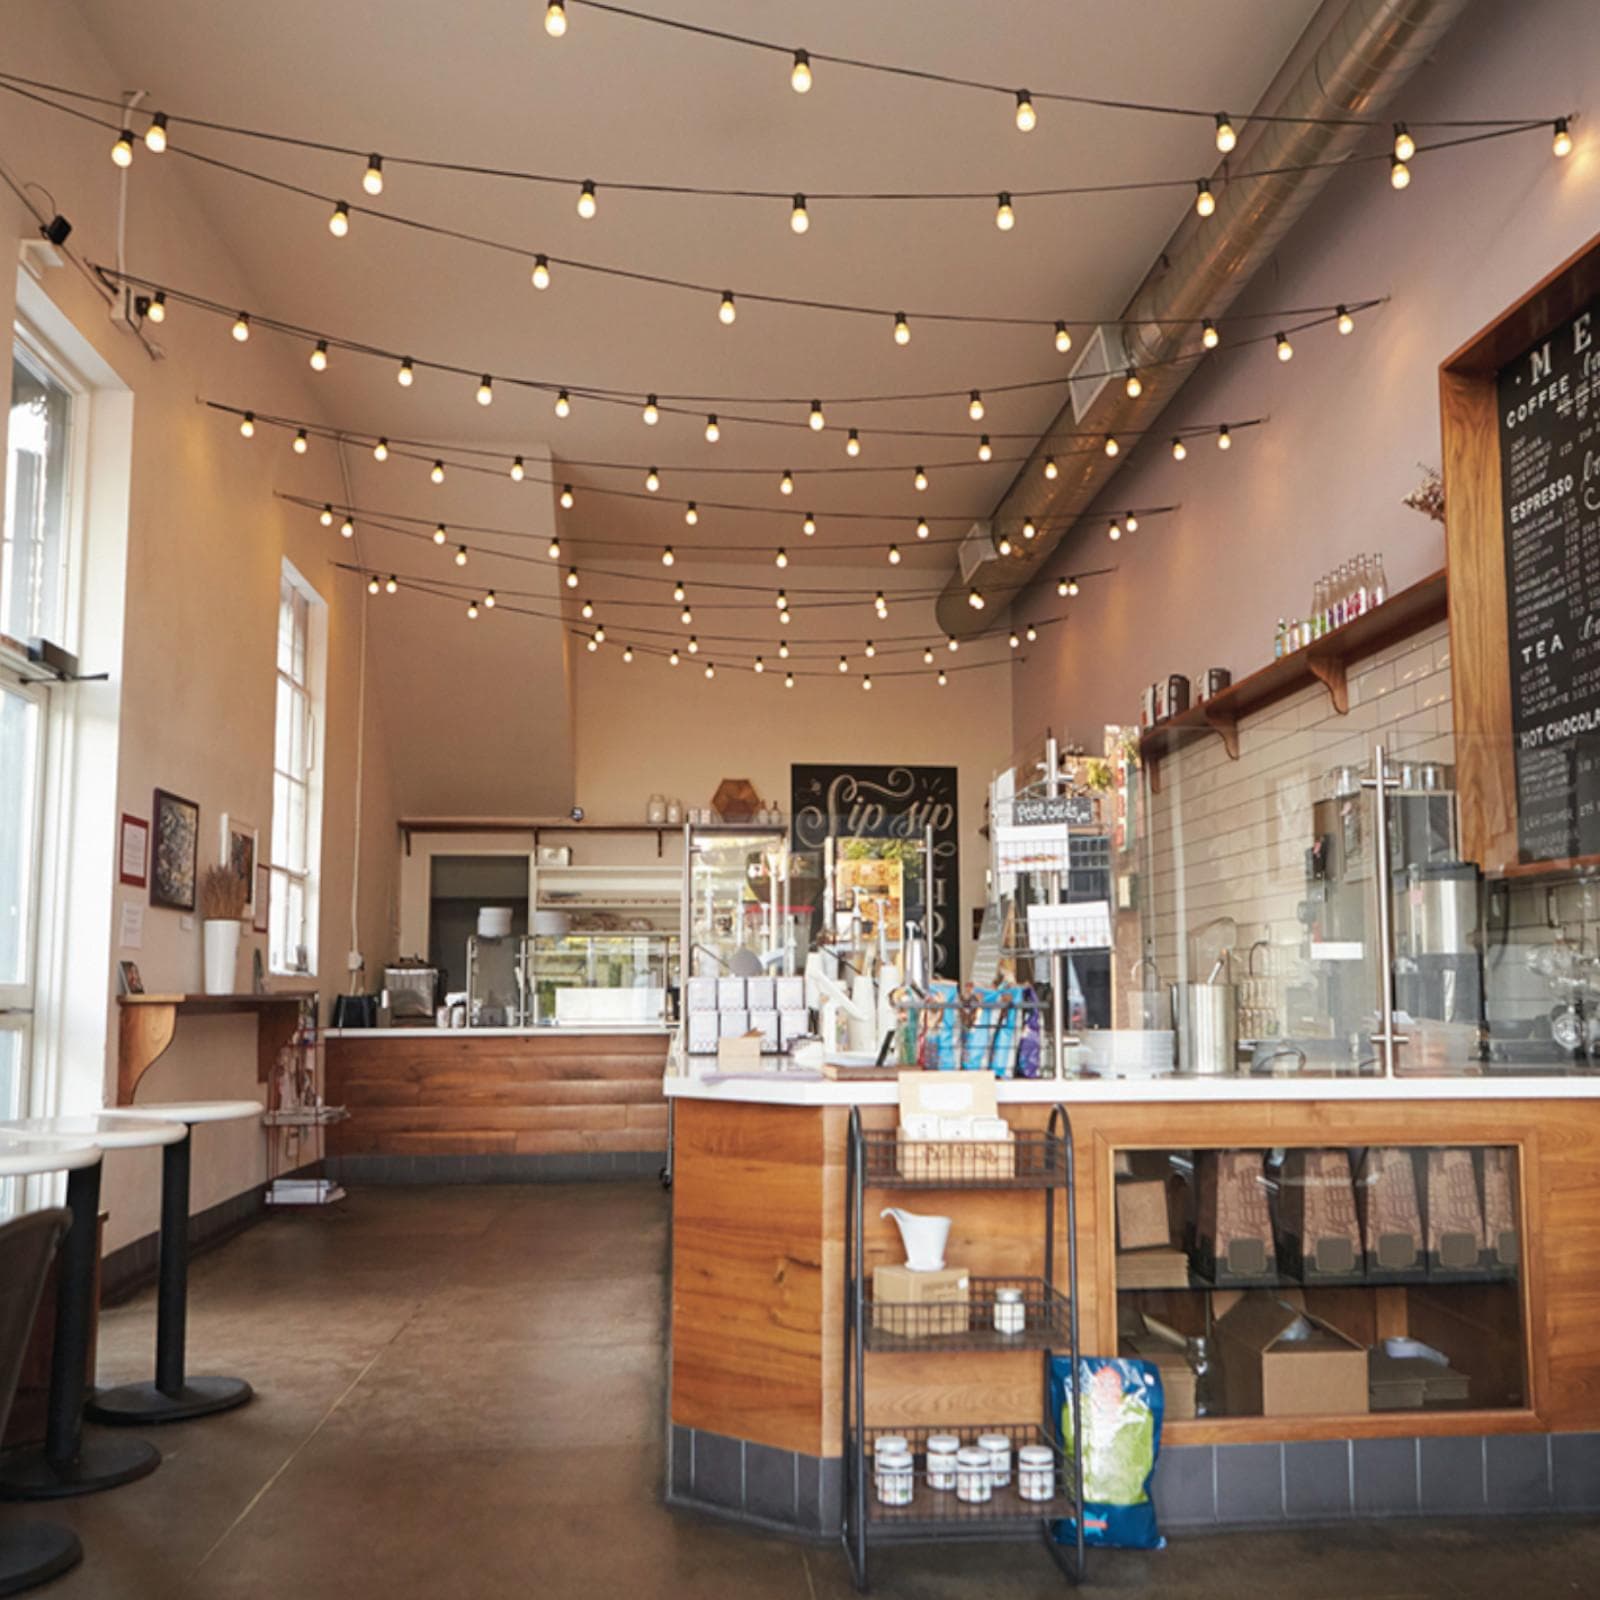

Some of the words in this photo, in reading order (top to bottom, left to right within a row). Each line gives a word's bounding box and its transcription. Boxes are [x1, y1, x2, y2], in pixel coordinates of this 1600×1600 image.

[1506, 374, 1569, 429] COFFEE
[1510, 474, 1574, 523] ESPRESSO
[1521, 634, 1564, 665] TEA
[1520, 726, 1545, 750] HOT
